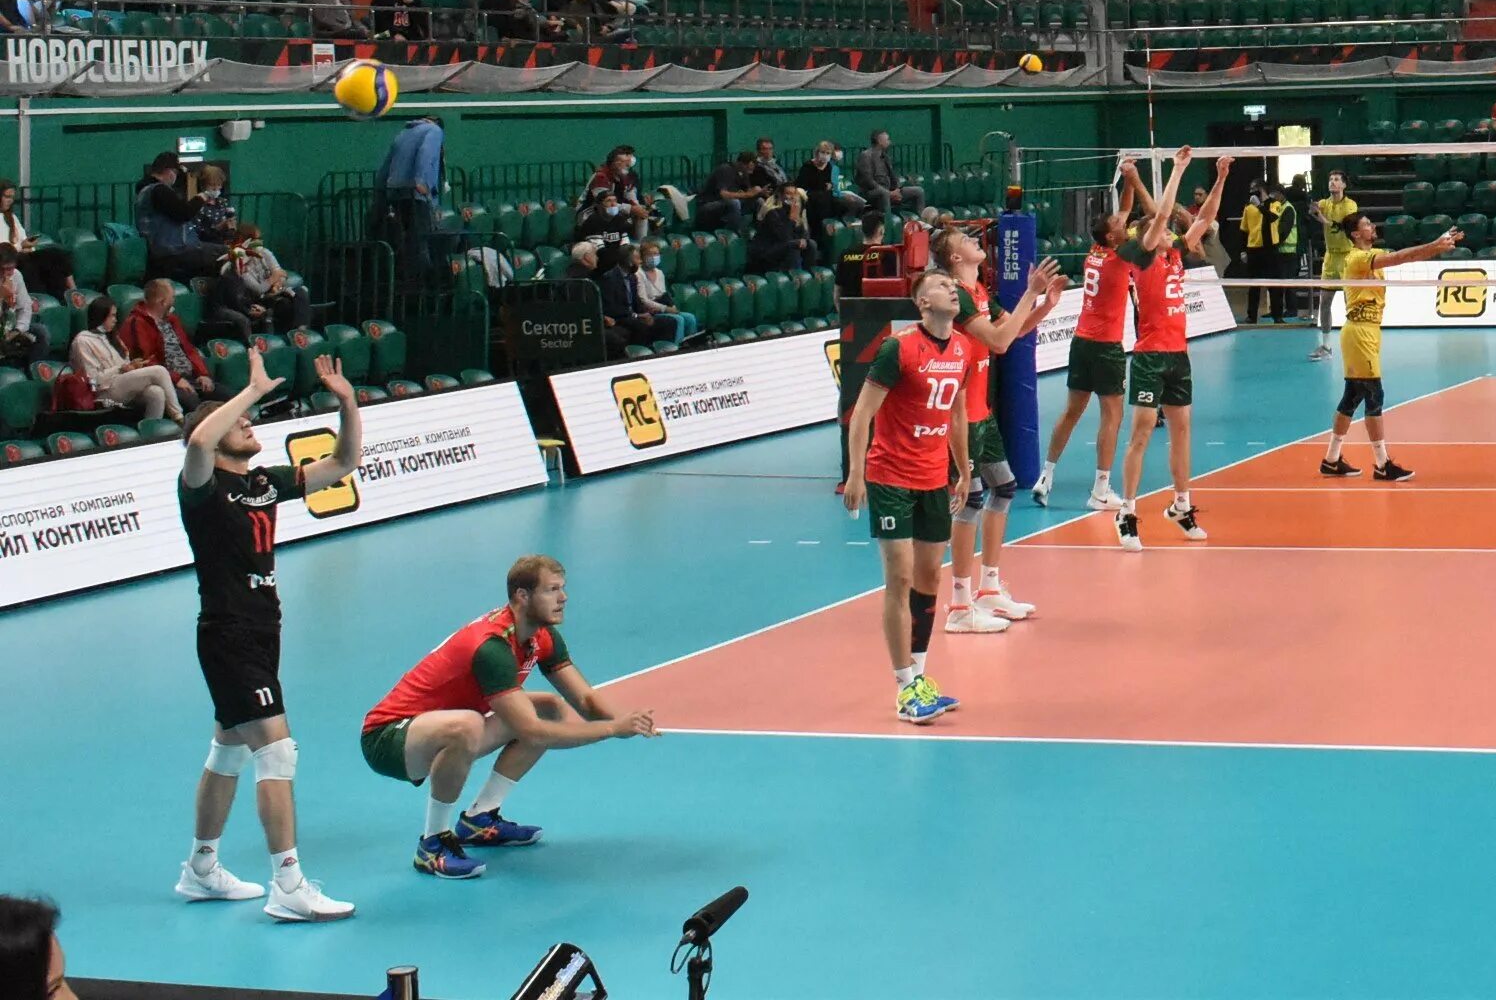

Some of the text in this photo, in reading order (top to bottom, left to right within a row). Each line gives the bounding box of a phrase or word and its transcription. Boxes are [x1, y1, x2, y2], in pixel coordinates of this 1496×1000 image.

[6, 38, 211, 84] НОВОСИБИРСК
[1010, 230, 1020, 280] Sports
[1084, 268, 1100, 297] 8
[1443, 285, 1478, 303] RC
[522, 319, 578, 337] Сектор
[540, 338, 574, 348] Sector
[658, 376, 745, 401] транспортная компания
[926, 377, 960, 411] 10
[1138, 391, 1154, 403] 23
[621, 394, 656, 429] RC
[662, 391, 751, 421] РЕЙЛ КОНТИНЕНТ
[425, 426, 472, 446] компания
[358, 443, 479, 483] РЕЙЛ КОНТИНЕНТ
[71, 491, 136, 516] компания
[0, 511, 143, 559] ЙЛ КОНТИНЕНТ
[248, 510, 272, 553] 11
[879, 516, 896, 531] 10
[255, 686, 275, 707] 11
